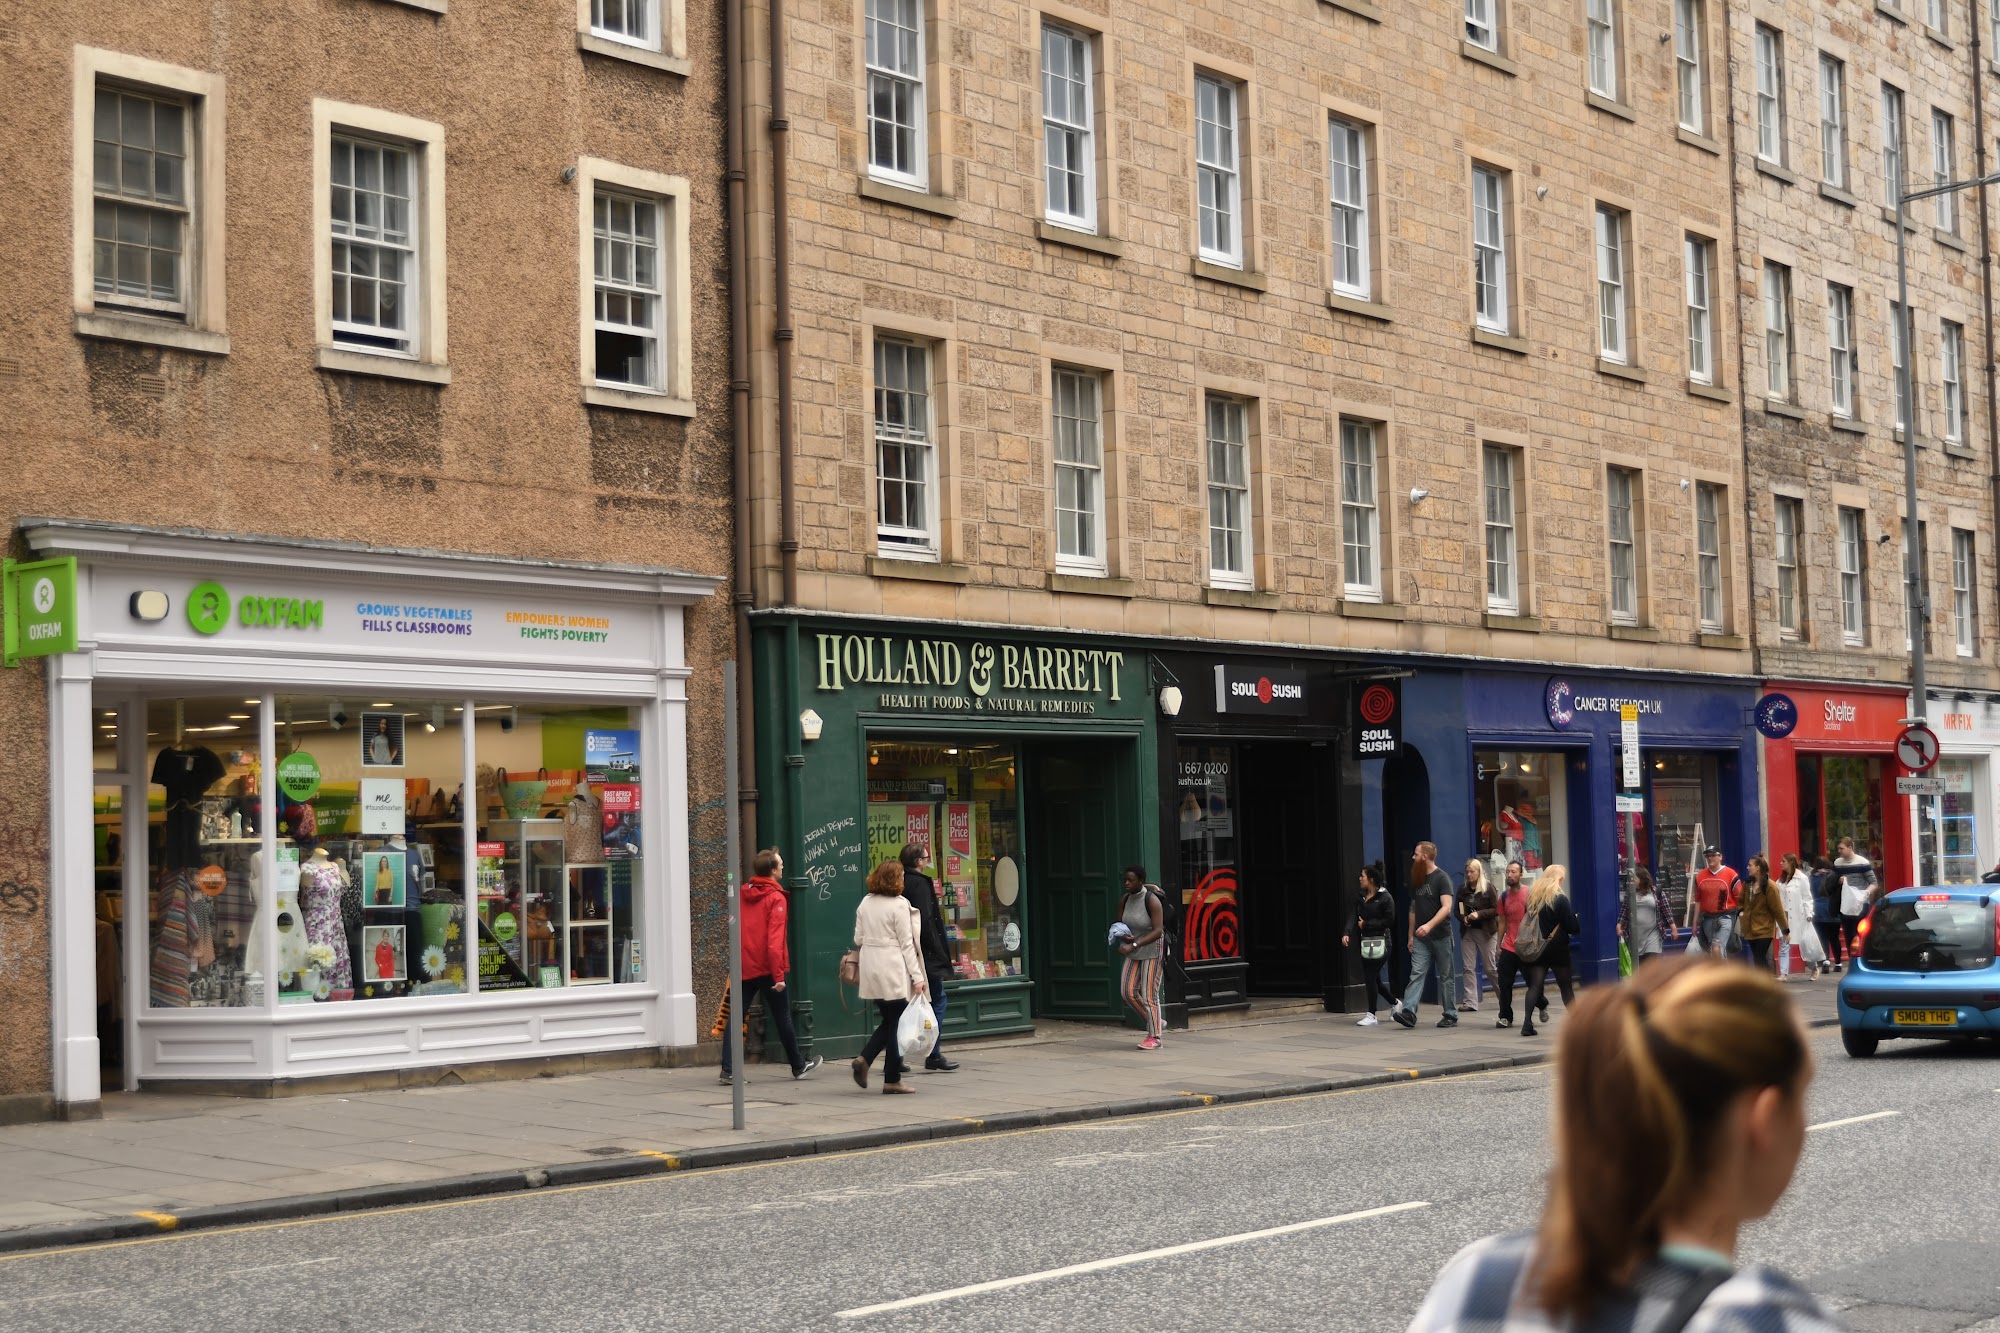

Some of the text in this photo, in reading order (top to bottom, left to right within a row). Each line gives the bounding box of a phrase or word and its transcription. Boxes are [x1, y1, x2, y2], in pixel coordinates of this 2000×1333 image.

[240, 595, 324, 628] OXFAM
[357, 603, 473, 621] GROWS VEGETABLES
[362, 619, 472, 635] FILLS CLASSROOMS
[506, 612, 609, 629] EMPOWERS WOMEN
[29, 622, 62, 640] OXFAM
[521, 627, 608, 643] FIGHTS POVERTY
[816, 633, 1124, 700] HOLLAND & BARRETT
[1231, 682, 1301, 698] SOUL SUSHI
[881, 694, 1095, 713] HEALTH FOODS & NATURAL REMEDIES
[1574, 696, 1607, 712] CANCER
[1651, 700, 1662, 713] UK
[1824, 699, 1856, 722] Shelter
[1823, 721, 1841, 731] Scotland
[1943, 713, 1956, 730] MR
[1958, 713, 1972, 731] FIX
[1361, 729, 1392, 741] SOUL
[587, 735, 595, 752] 8
[1359, 740, 1395, 752] SUSHI
[279, 770, 320, 778] VOLUNTEERS
[1184, 762, 1201, 774] 667
[1204, 762, 1228, 775] 0200
[548, 778, 571, 787] ASHION
[867, 780, 894, 792] OLLAND
[1898, 782, 1924, 791] Except
[375, 794, 392, 803] me
[317, 810, 330, 818] FAIR
[950, 813, 968, 827] Half
[317, 818, 337, 826] CARDS
[907, 814, 929, 830] Half
[868, 823, 905, 845] etter
[907, 830, 929, 844] Price
[950, 826, 969, 838] Price
[479, 954, 506, 965] ONLINE
[479, 965, 500, 975] SHOP
[544, 973, 559, 981] YOUR
[544, 980, 561, 988] LOFT!
[1898, 1011, 1950, 1022] SM08 THG
